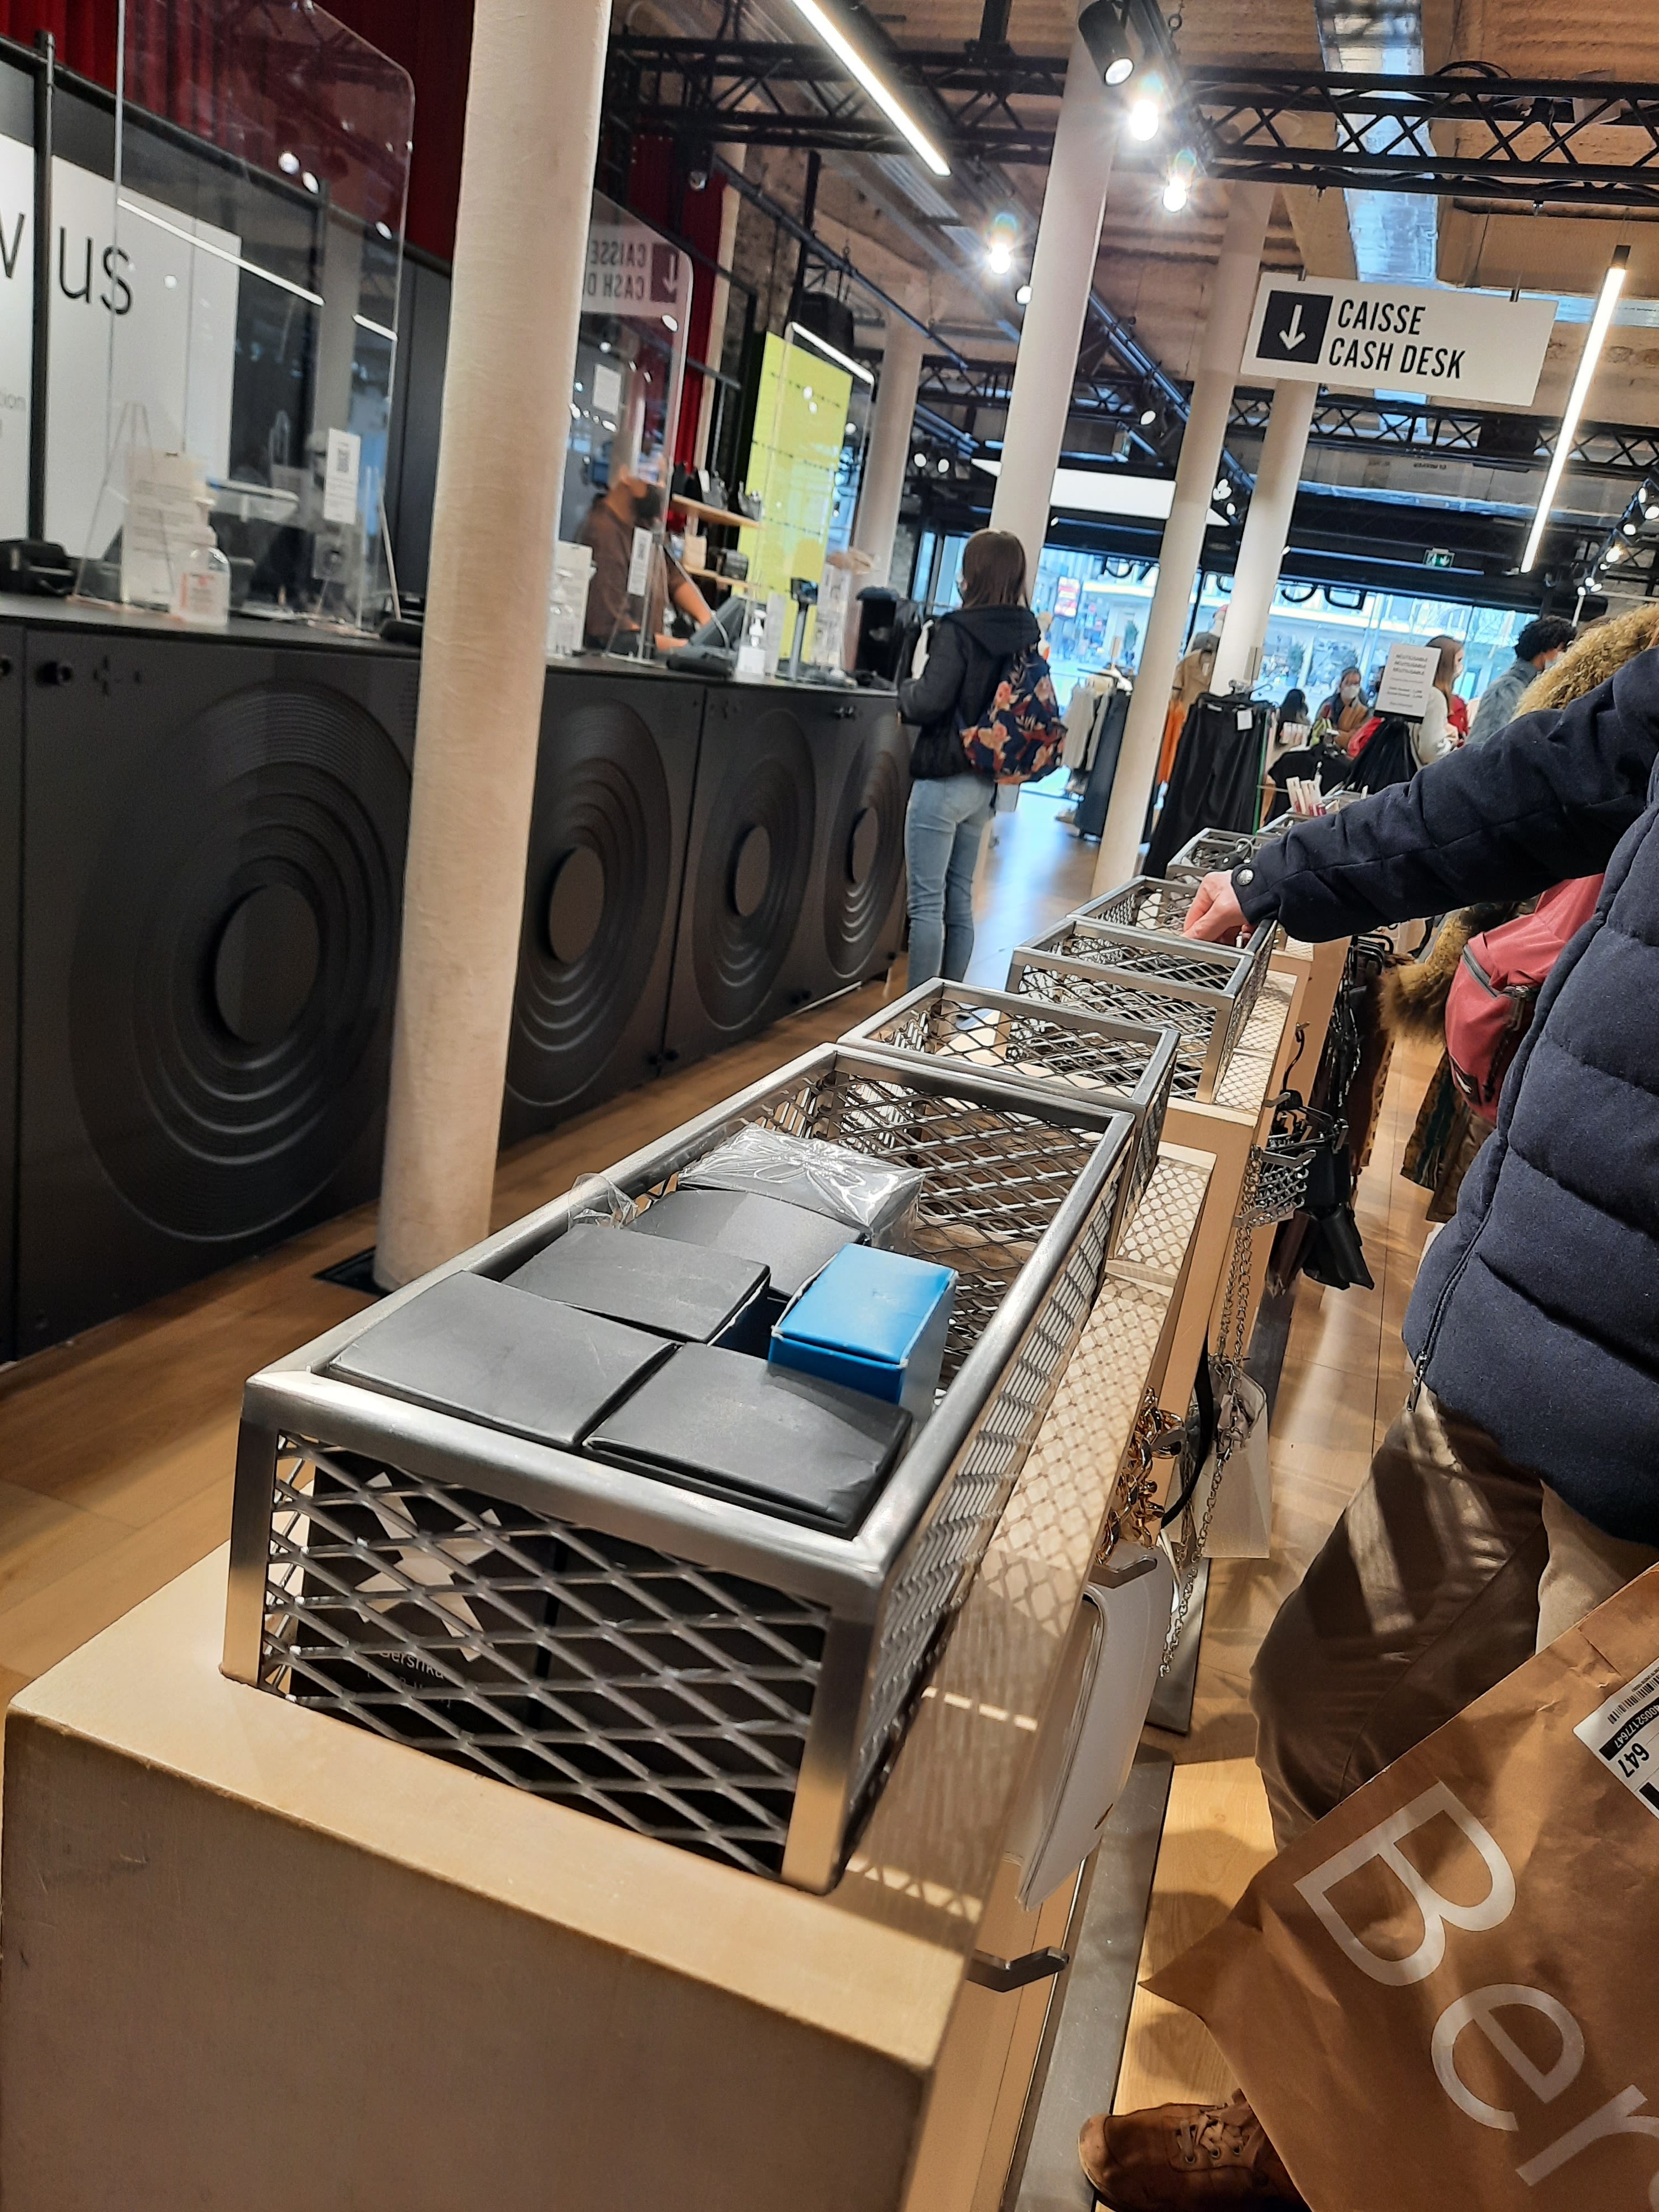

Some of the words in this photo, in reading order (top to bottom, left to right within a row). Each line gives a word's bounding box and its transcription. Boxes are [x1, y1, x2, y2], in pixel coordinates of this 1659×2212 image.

[59, 226, 132, 315] us
[1337, 299, 1426, 336] CAISSE
[1328, 337, 1394, 372] CASH
[1399, 344, 1466, 379] DESK
[1618, 1743, 1650, 1778] 647
[1293, 1780, 1659, 2212] Ber
